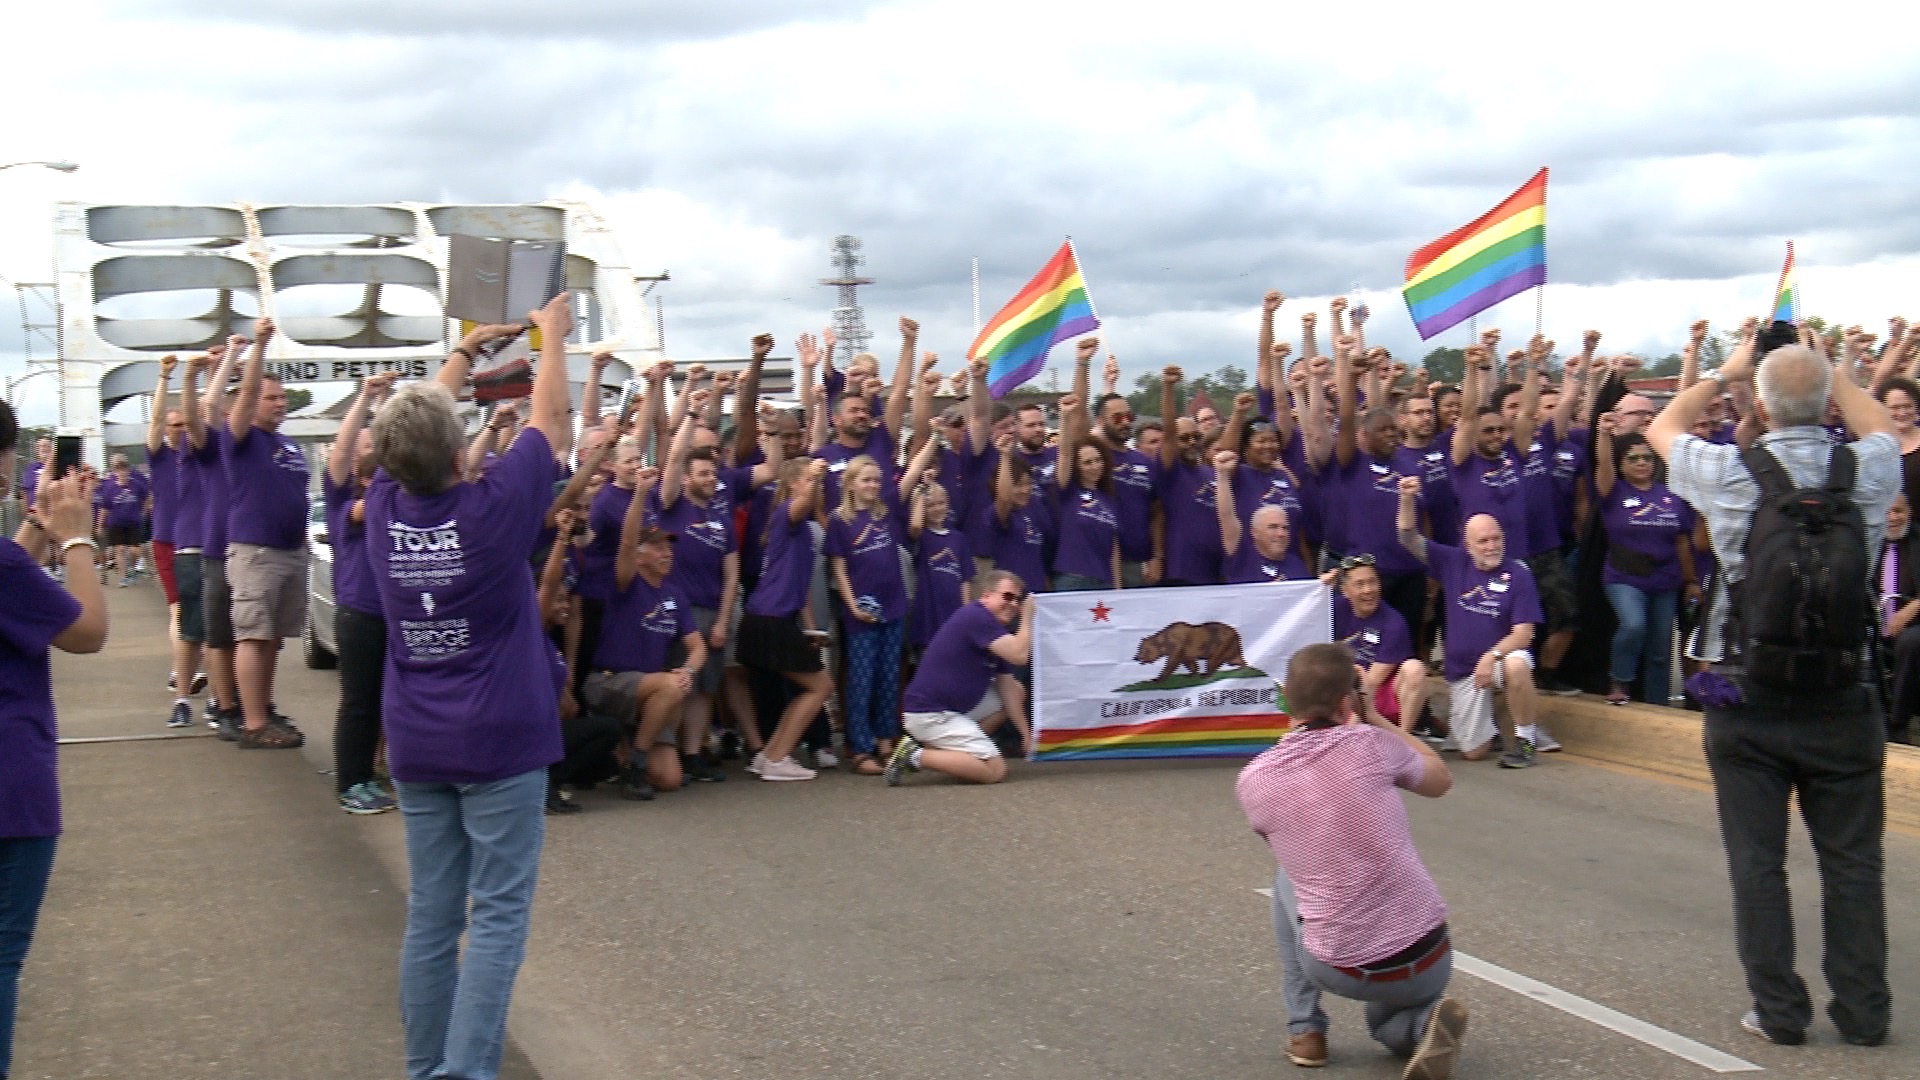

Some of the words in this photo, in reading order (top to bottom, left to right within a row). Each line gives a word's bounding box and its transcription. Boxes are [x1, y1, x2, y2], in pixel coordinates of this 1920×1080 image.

[331, 360, 427, 378] PETTUS
[388, 530, 461, 552] TOUR
[388, 551, 410, 562] SAN
[411, 550, 464, 561] FRANCISCO
[402, 629, 471, 647] BRIDGE
[1101, 697, 1192, 718] CALIFORNIA
[1198, 687, 1277, 708] REPUBLIC
